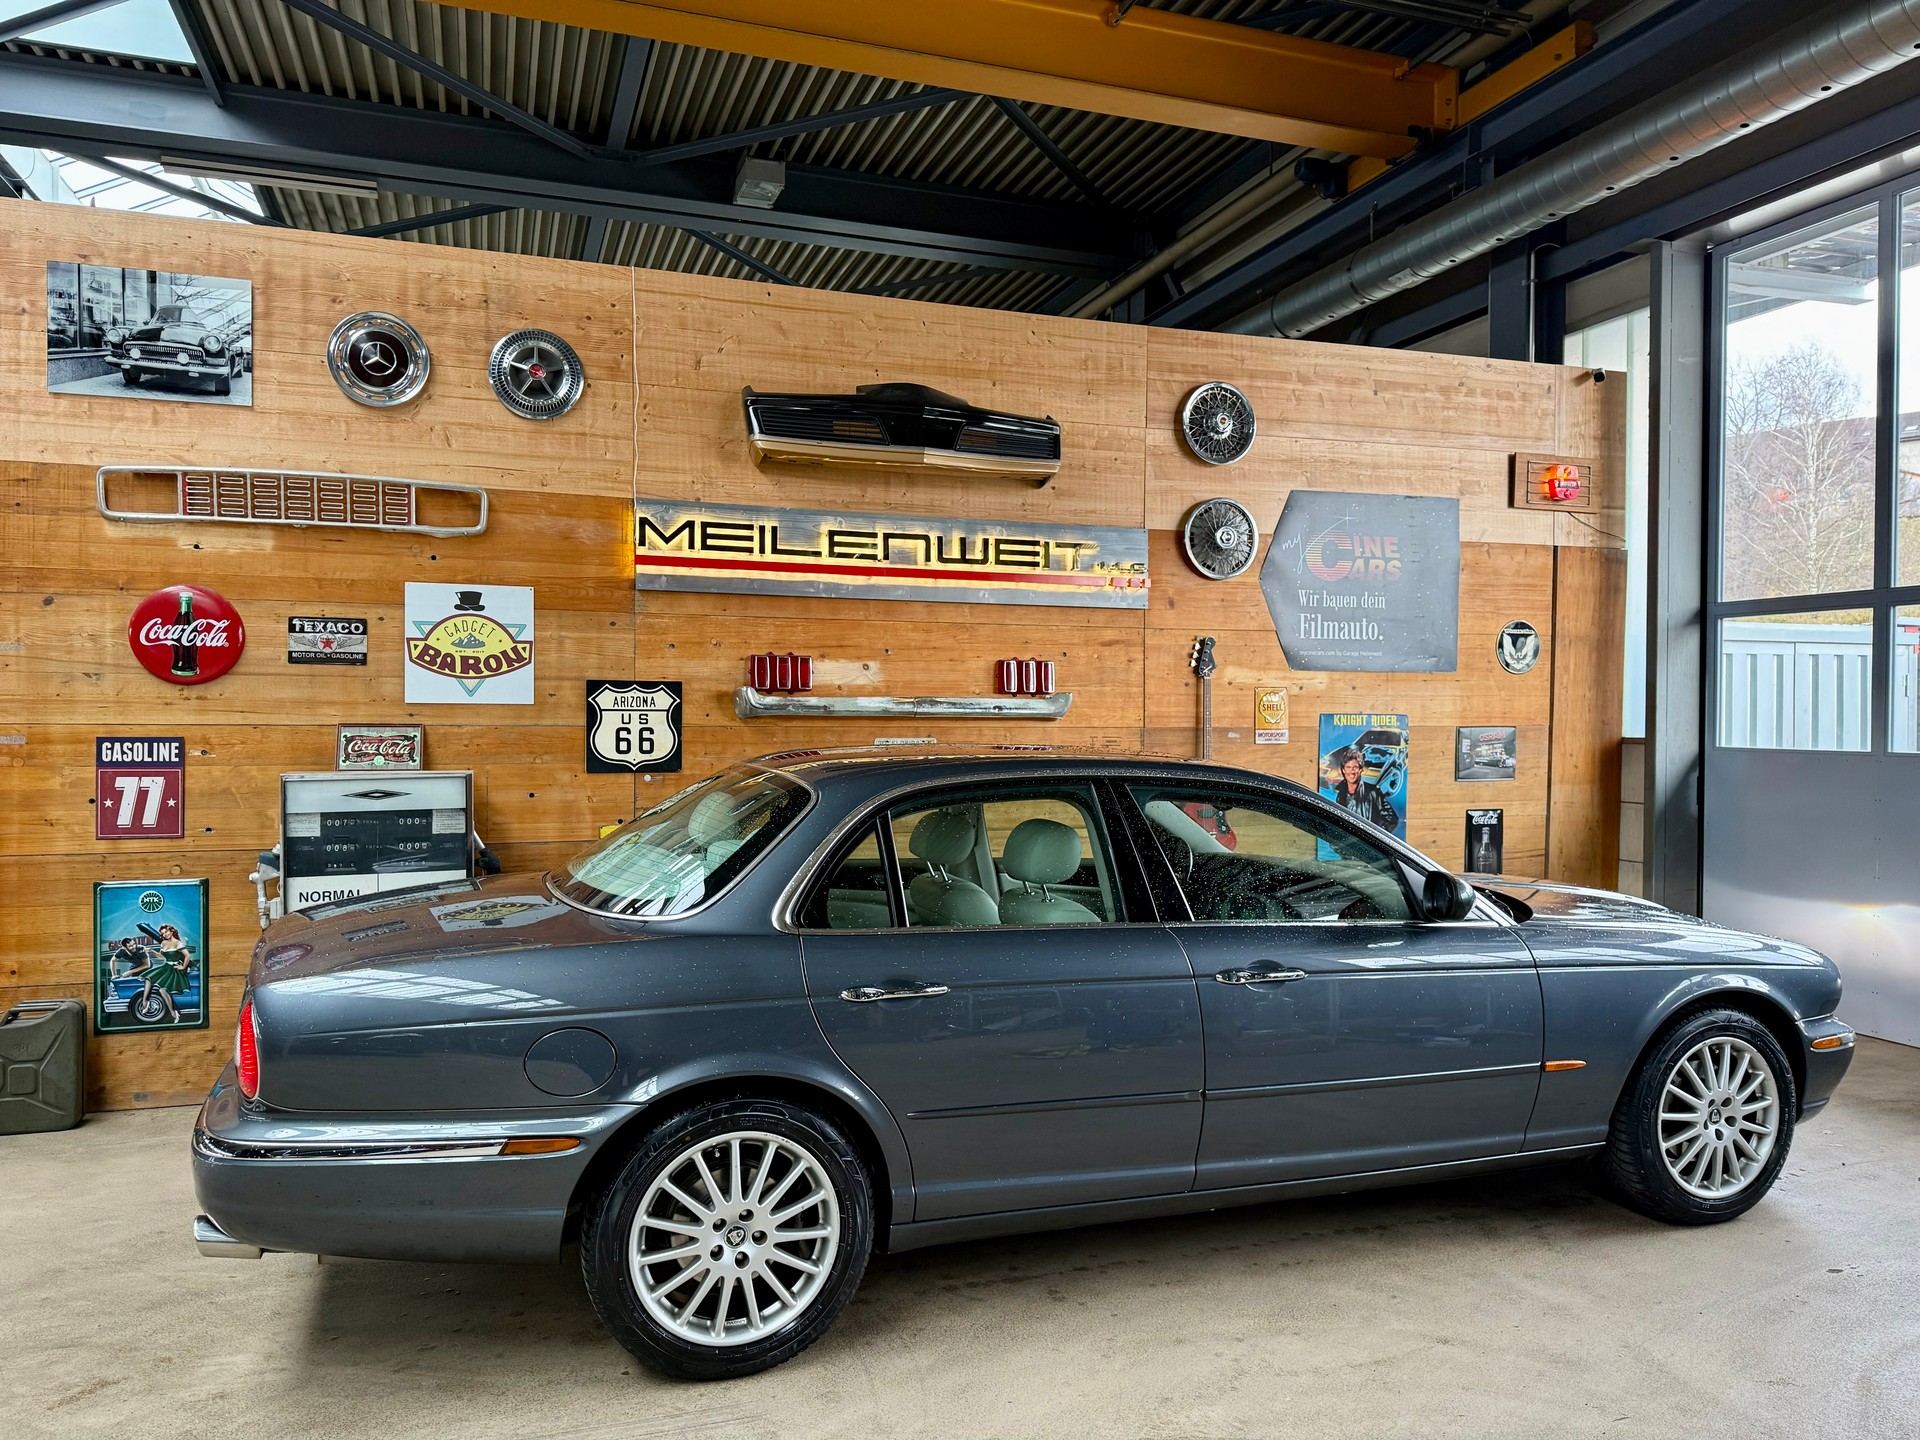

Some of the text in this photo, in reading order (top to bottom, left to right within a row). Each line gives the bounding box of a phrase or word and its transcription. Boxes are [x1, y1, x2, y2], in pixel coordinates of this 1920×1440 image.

[1298, 590, 1386, 610] Wir bauen dein
[139, 618, 231, 648] Coca-Cola
[292, 618, 364, 634] TEXACO
[443, 619, 496, 638] GADGET
[1298, 613, 1384, 641] Filmauto.
[414, 642, 528, 675] BARON
[613, 696, 656, 708] ARIZONA
[1262, 703, 1284, 711] SHELL
[1333, 714, 1368, 727] KNIGHT
[615, 727, 655, 755] 66
[101, 742, 180, 762] GASOLINE
[114, 776, 166, 828] 77
